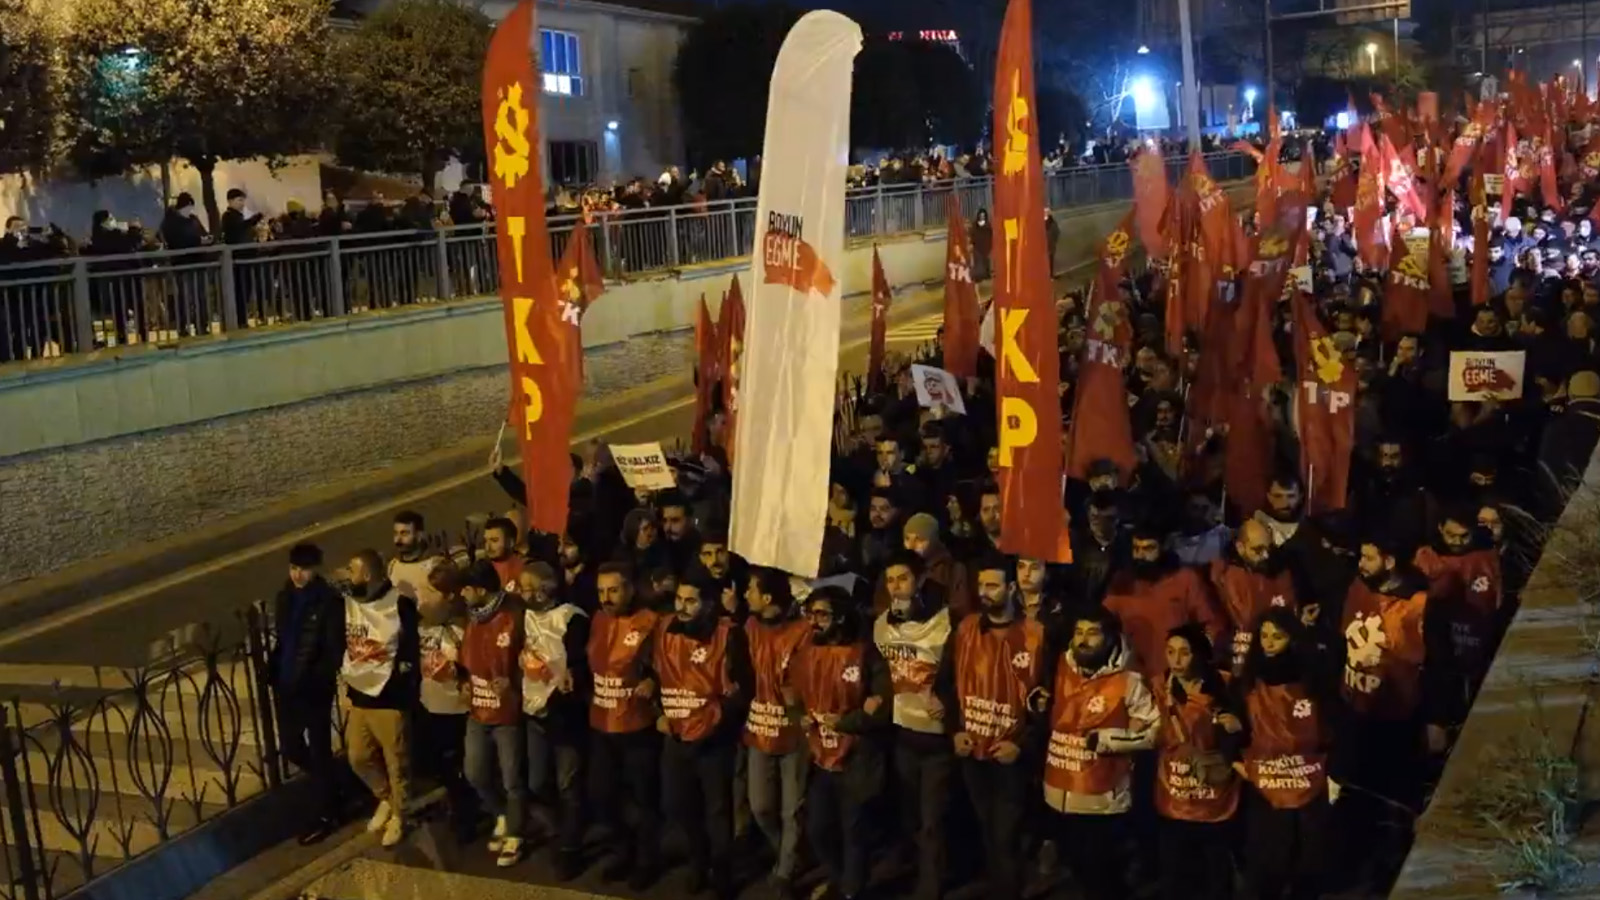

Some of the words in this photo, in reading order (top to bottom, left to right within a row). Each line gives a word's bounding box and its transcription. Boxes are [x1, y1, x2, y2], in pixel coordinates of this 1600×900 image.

[768, 210, 803, 239] BOYUN
[766, 235, 803, 270] EGME
[1465, 368, 1497, 384] EGME
[1303, 381, 1350, 414] TP
